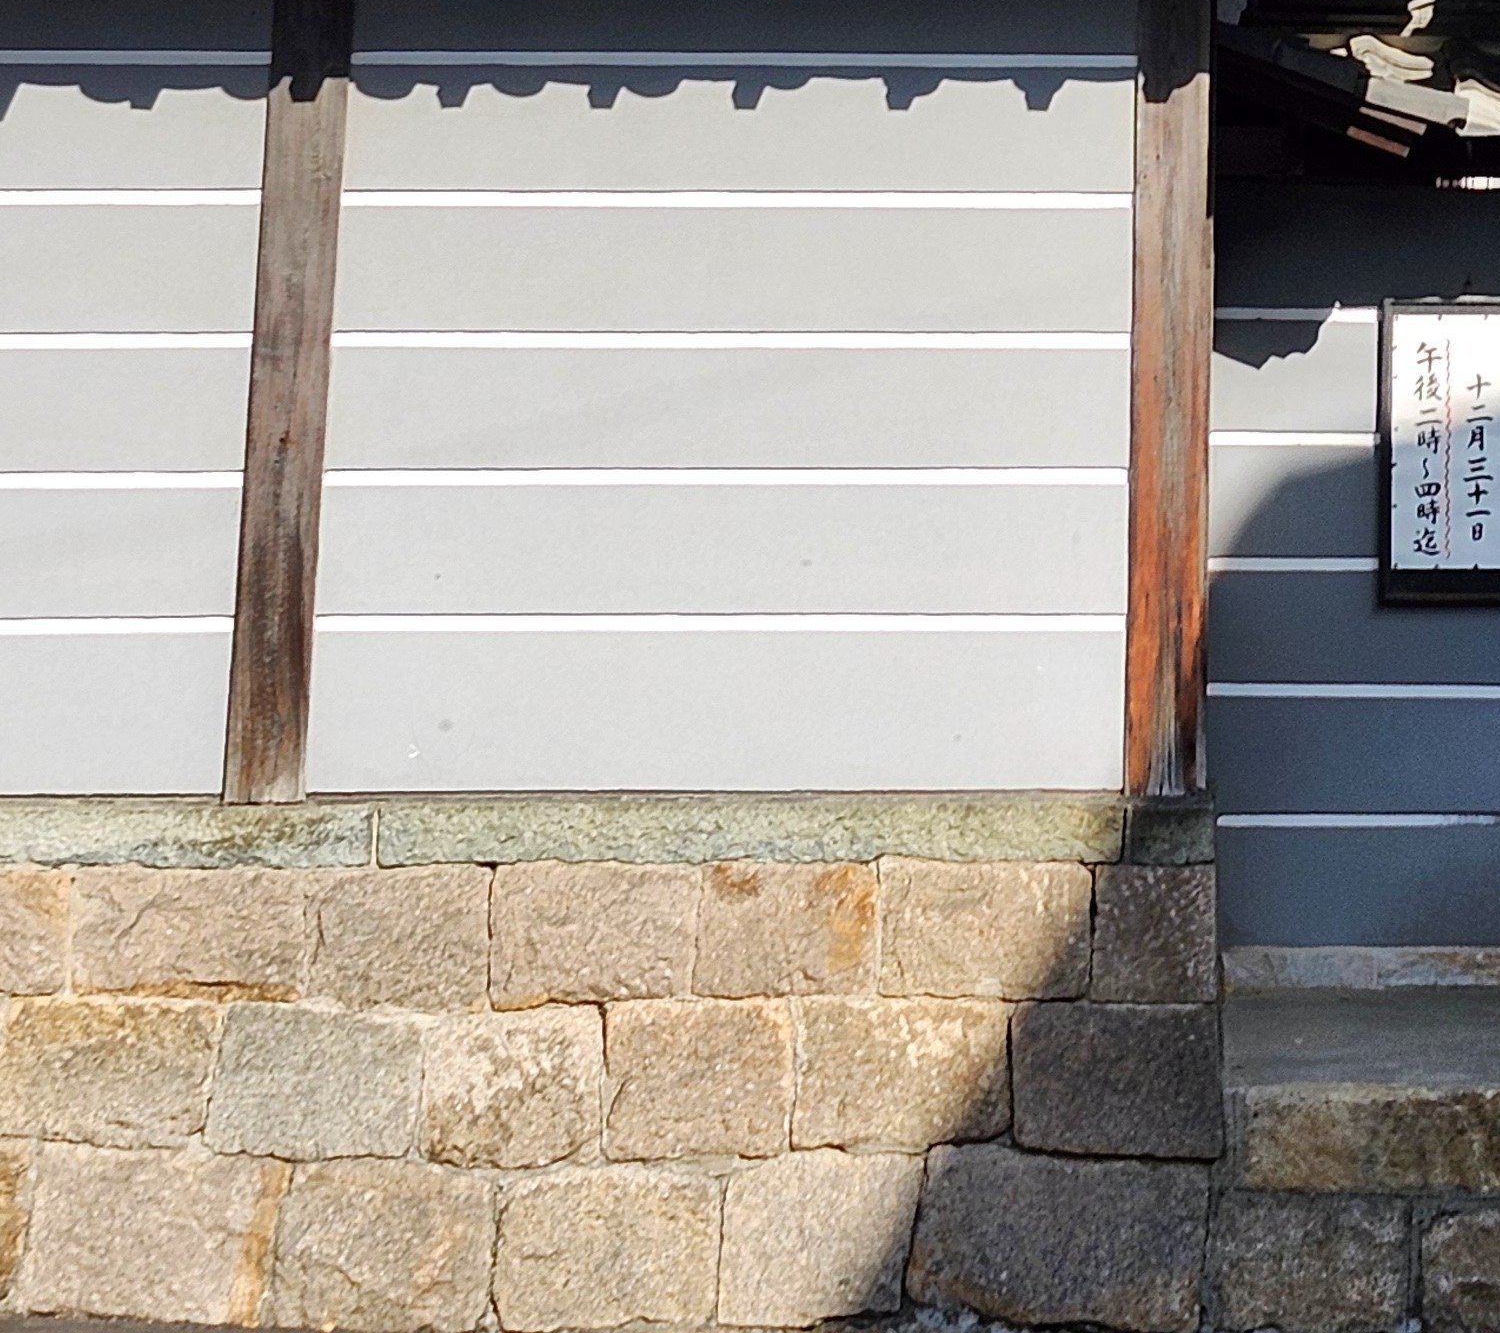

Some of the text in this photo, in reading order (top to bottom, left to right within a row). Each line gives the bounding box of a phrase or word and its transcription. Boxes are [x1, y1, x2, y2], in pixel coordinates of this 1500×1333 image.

[1464, 374, 1494, 542] 十二月三十一日
